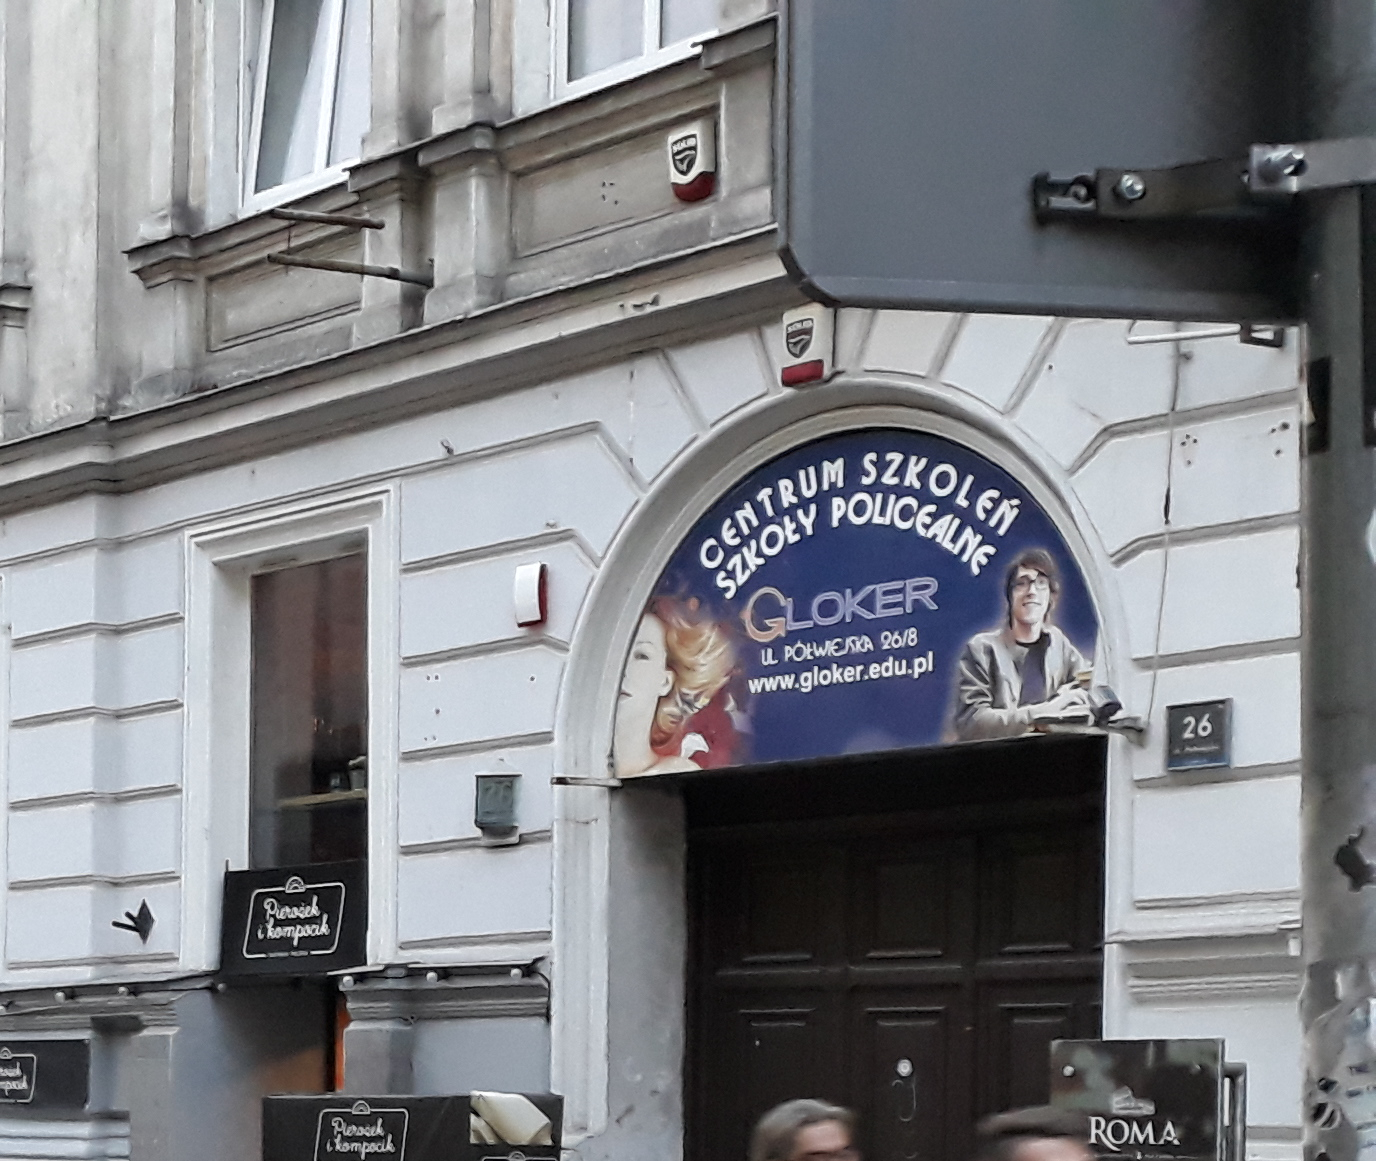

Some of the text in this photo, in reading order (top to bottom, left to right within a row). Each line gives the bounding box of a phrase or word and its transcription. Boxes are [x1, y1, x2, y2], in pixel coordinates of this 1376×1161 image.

[700, 452, 1021, 570] CENTRUM SZKOLEŃ
[715, 492, 997, 600] SZKOŁY POLICEALNE
[744, 577, 939, 643] GLOKER
[784, 634, 874, 662] PÓŁWIEJSKA
[880, 627, 919, 651] 26/8
[748, 651, 935, 694] www.gloker.edu.pl
[1182, 713, 1213, 739] 26
[1089, 1116, 1181, 1152] ROMA
